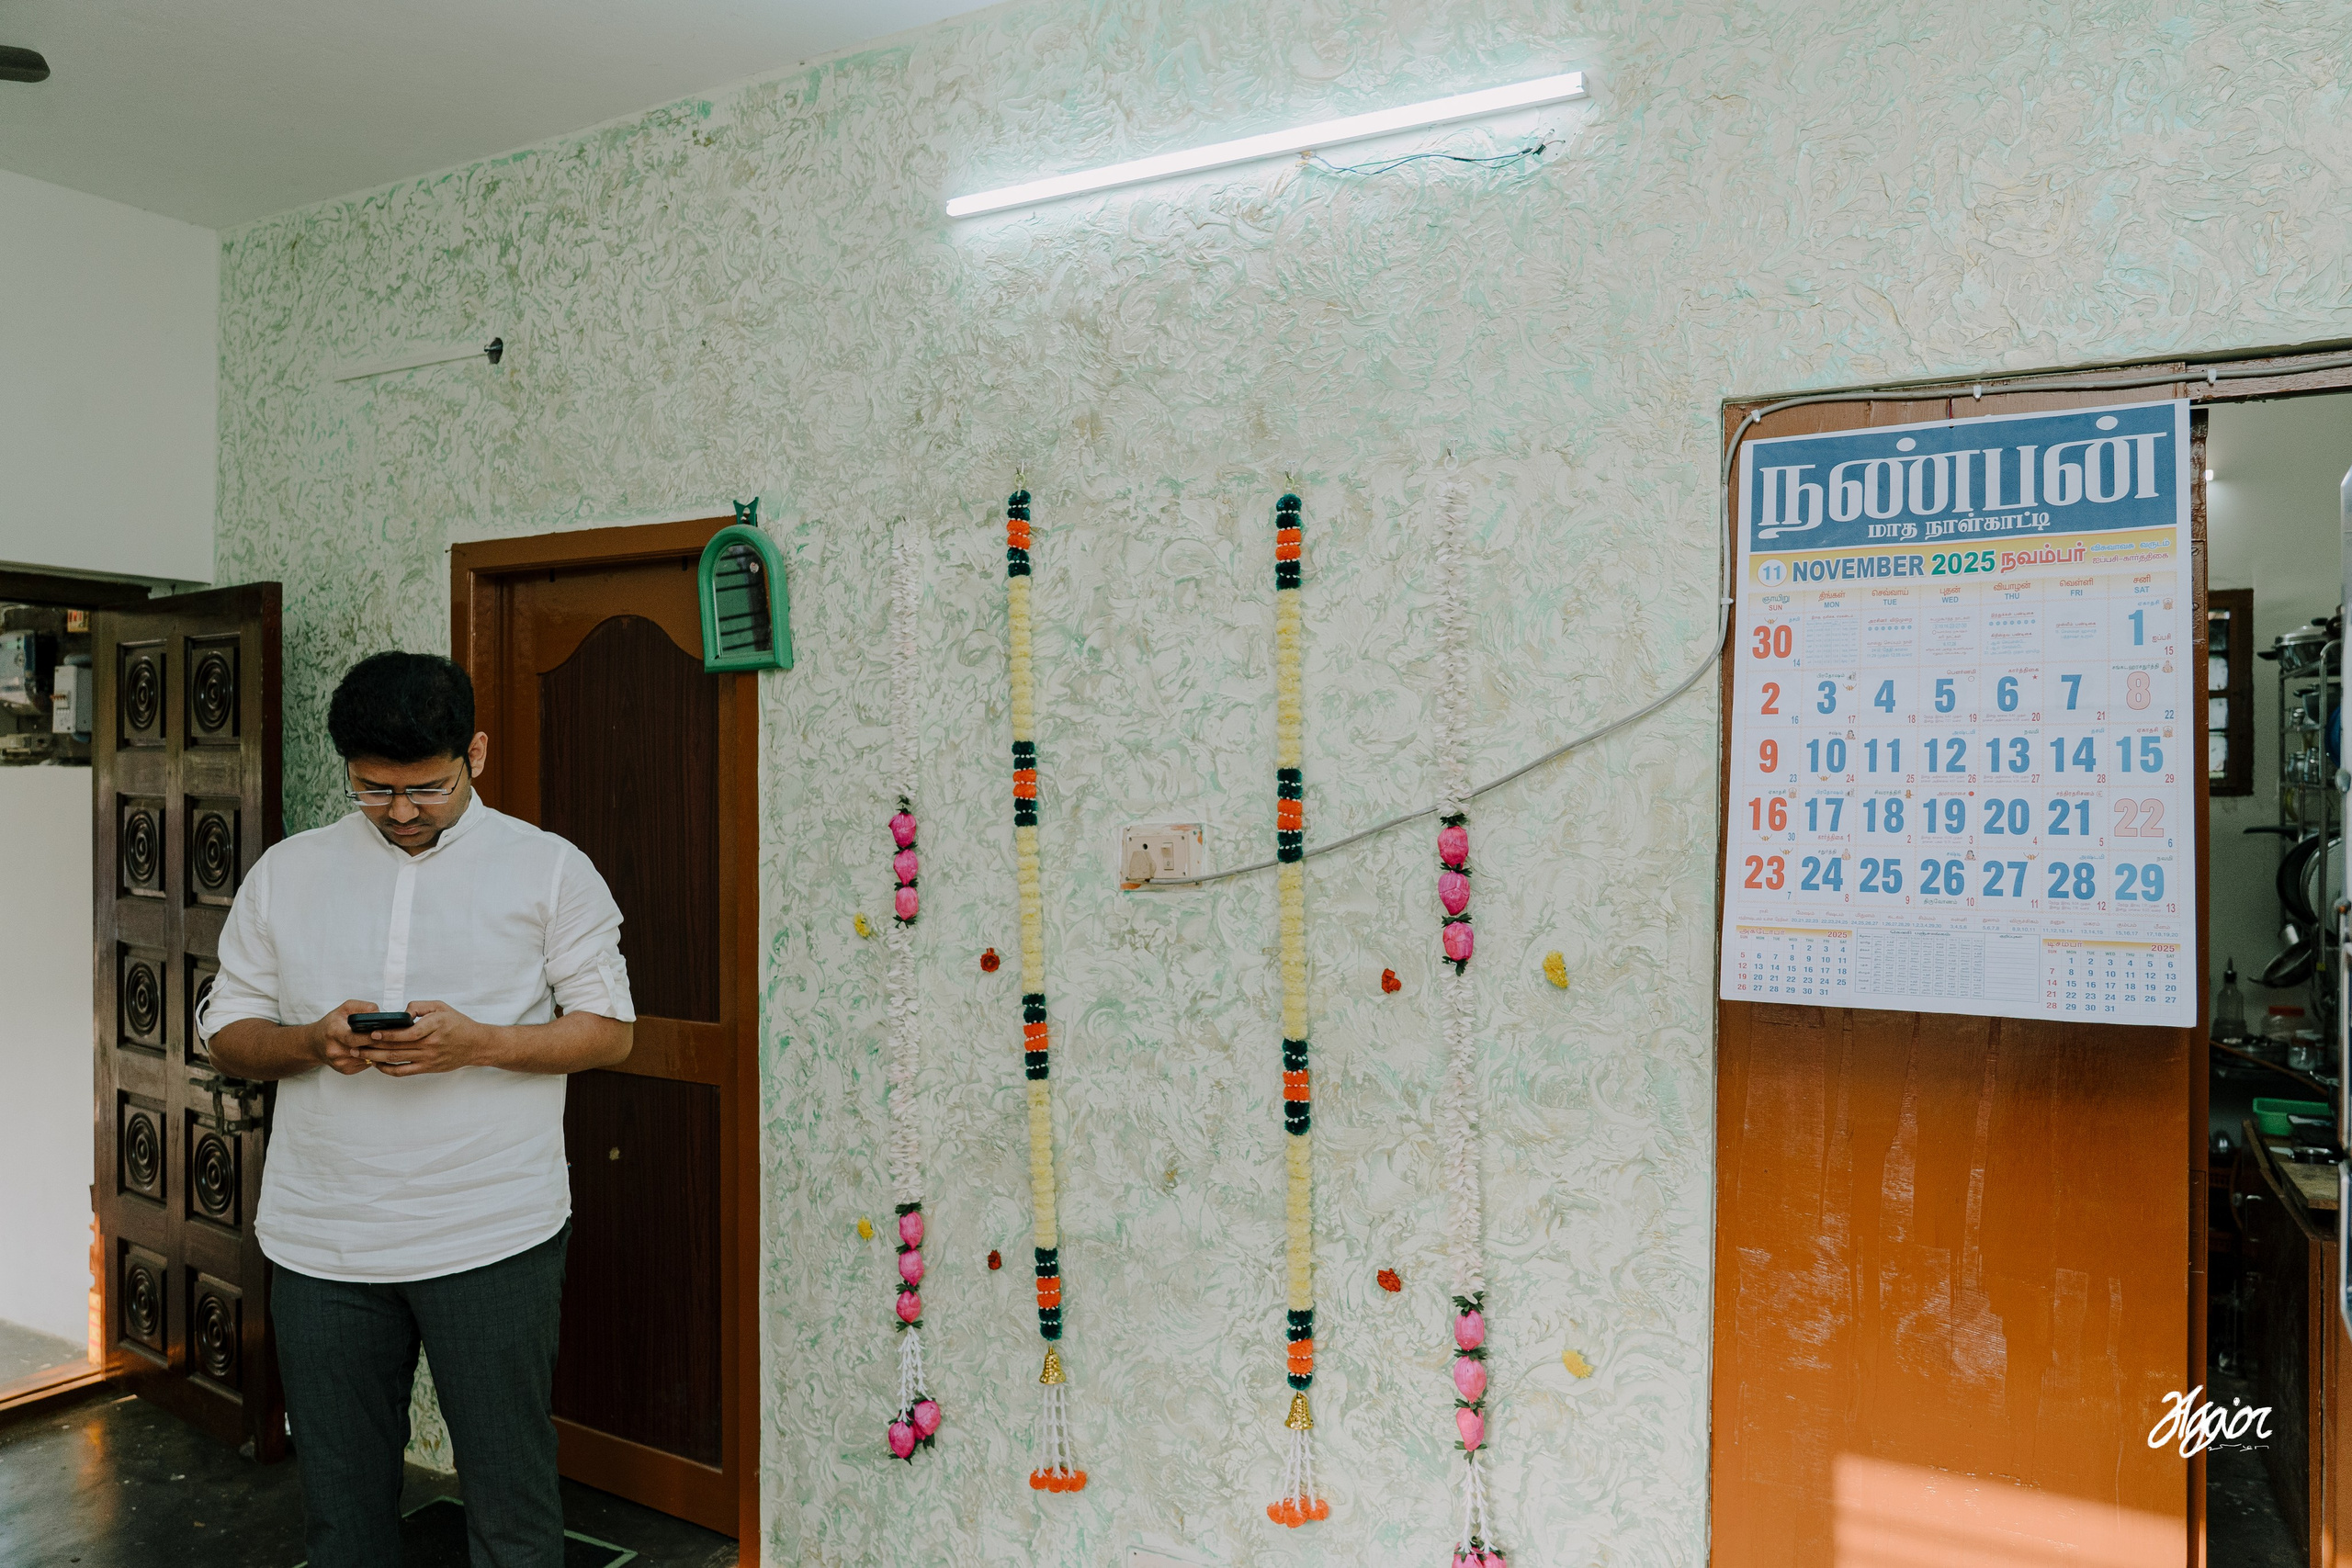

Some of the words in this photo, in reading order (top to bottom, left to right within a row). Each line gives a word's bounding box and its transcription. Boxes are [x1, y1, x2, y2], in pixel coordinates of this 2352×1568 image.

[1758, 415, 2167, 540] நண்பன்
[1867, 522, 1917, 541] மாத
[1925, 511, 2051, 541] நாள்காட்டி
[1762, 565, 1781, 581] 11
[1792, 555, 1925, 582] NOVEMBER
[1930, 549, 1996, 575] 2025
[2000, 542, 2086, 574] நவம்பர்
[1761, 594, 1791, 604] ஞாயிறு
[1818, 591, 1846, 602] திங்கள்
[1871, 586, 1908, 597] செவ்வாய்
[1939, 585, 1961, 596] புதன்
[1993, 581, 2031, 592] வியாழன்
[2059, 577, 2094, 588] வெள்ளி
[2132, 574, 2152, 584] சனி
[1753, 625, 1792, 659] 30
[2129, 610, 2143, 645] 1
[1793, 659, 1800, 667] 14
[2165, 646, 2173, 655] 15
[1761, 682, 1780, 715] 2
[1817, 681, 1836, 714] 3
[1874, 680, 1895, 713] 4
[1935, 679, 1955, 713] 5
[1997, 676, 2018, 712] 6
[2061, 674, 2082, 710] 7
[2126, 671, 2151, 710] 8
[1792, 716, 1798, 724] 16
[1908, 715, 1916, 723] 18
[1970, 714, 1976, 722] 19
[2032, 713, 2040, 721] 20
[2098, 711, 2105, 720] 21
[2165, 710, 2174, 719] 22
[1759, 739, 1778, 773] 9
[1806, 739, 1846, 773] 10
[1864, 739, 1900, 773] 11
[1924, 738, 1966, 773] 12
[1986, 737, 2030, 773] 13
[2050, 737, 2096, 772] 14
[2116, 736, 2163, 773] 15
[1847, 774, 1854, 783] 24
[1906, 774, 1914, 783] 25
[1968, 774, 1976, 783] 26
[2031, 774, 2040, 783] 27
[2098, 774, 2106, 783] 28
[2165, 774, 2174, 783] 29
[1748, 797, 1787, 831] 16
[1805, 798, 1844, 831] 17
[1863, 798, 1904, 833] 18
[1923, 798, 1965, 834] 19
[1984, 798, 2030, 835] 20
[2049, 799, 2089, 835] 21
[2114, 798, 2165, 838] 22
[1788, 832, 1795, 840] 30
[1848, 834, 1849, 842] 1
[1907, 835, 1911, 843] 2
[1969, 836, 1973, 844] 3
[2033, 837, 2037, 845] 4
[2099, 838, 2103, 846] 5
[2168, 839, 2173, 847] 6
[1745, 855, 1784, 890] 23
[1801, 856, 1843, 891] 24
[1860, 858, 1903, 894] 25
[1920, 859, 1964, 896] 26
[1983, 861, 2028, 897] 27
[2048, 862, 2095, 899] 28
[2115, 863, 2164, 901] 29
[1845, 894, 1849, 902] 8
[1905, 896, 1909, 904] 9
[1966, 897, 1974, 906] 10
[2031, 899, 2038, 908] 11
[2098, 901, 2106, 910] 12
[2166, 903, 2176, 912] 13
[1827, 931, 1848, 939] 2025
[2151, 944, 2176, 953] 2025
